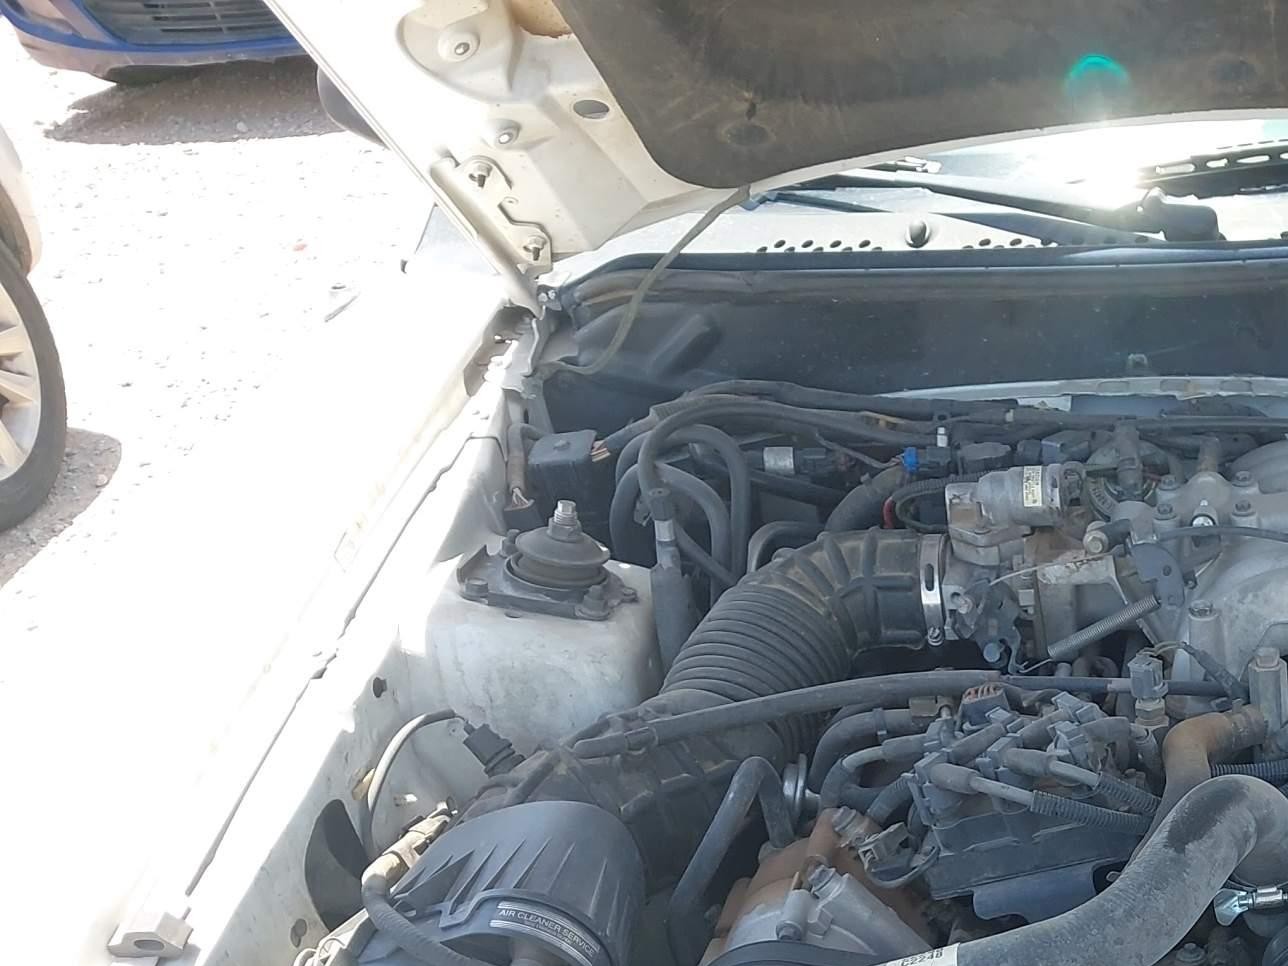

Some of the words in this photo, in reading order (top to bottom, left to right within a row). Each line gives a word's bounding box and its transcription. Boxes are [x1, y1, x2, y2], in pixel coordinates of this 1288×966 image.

[498, 909, 516, 918] AIR
[517, 912, 562, 933] CLEANER
[562, 928, 595, 957] SERVICE
